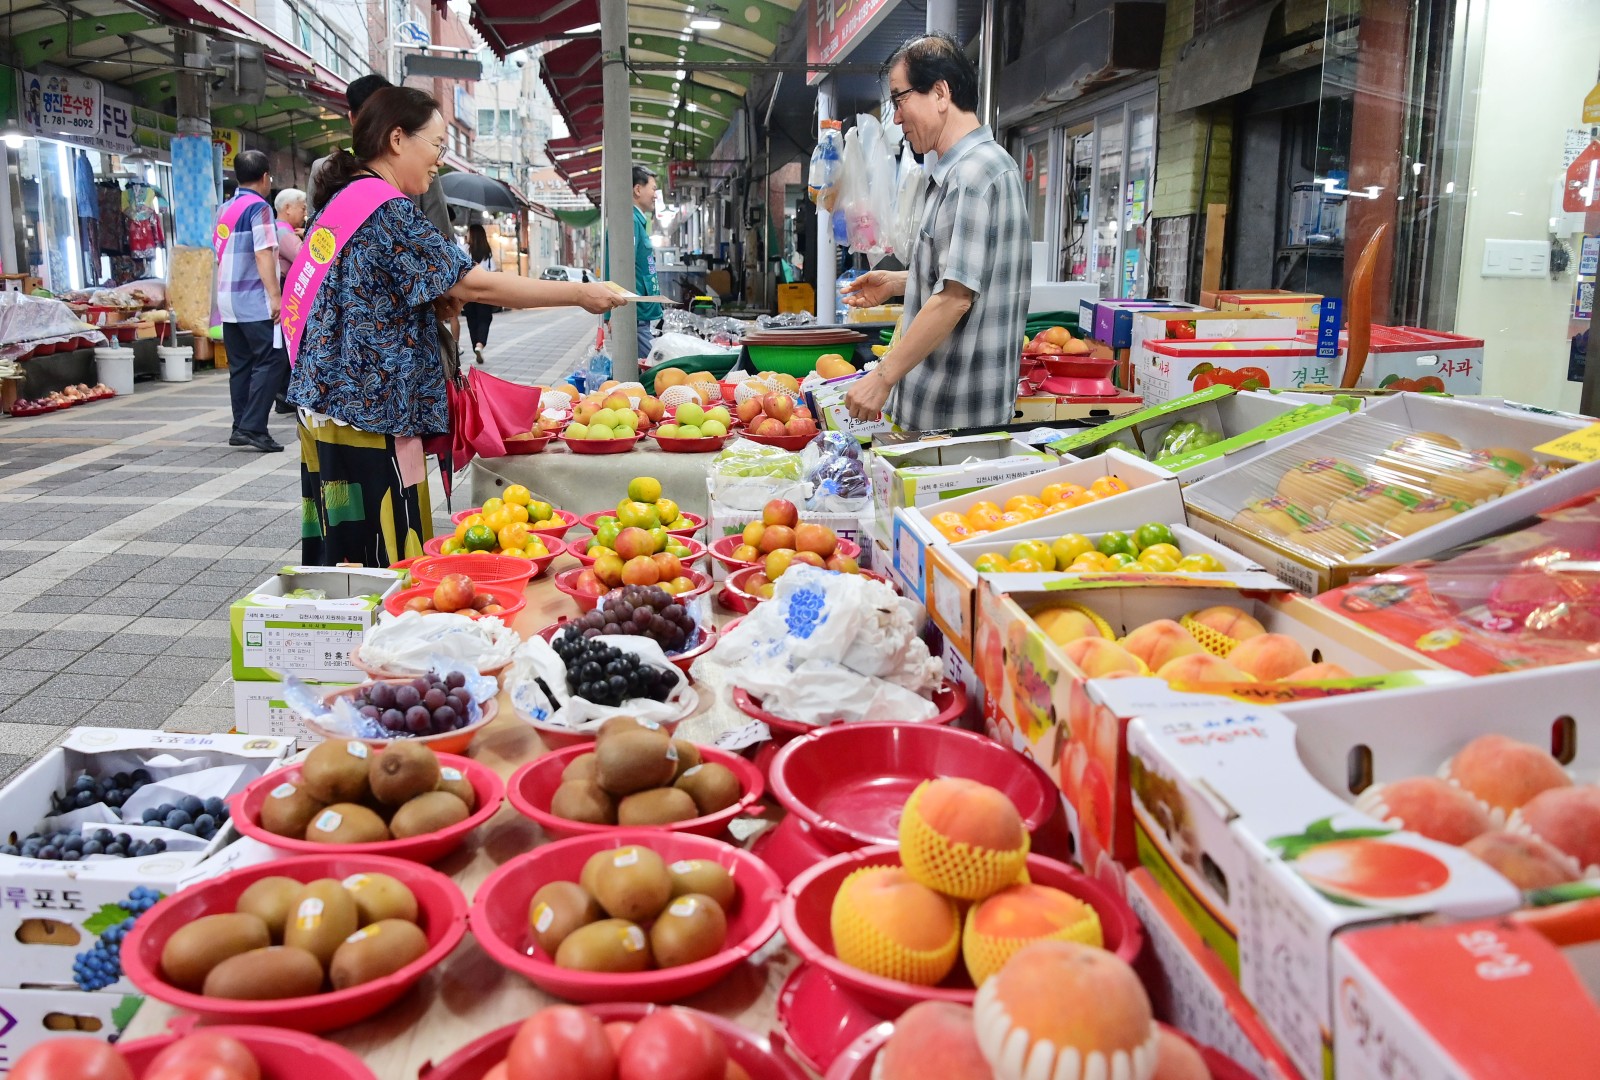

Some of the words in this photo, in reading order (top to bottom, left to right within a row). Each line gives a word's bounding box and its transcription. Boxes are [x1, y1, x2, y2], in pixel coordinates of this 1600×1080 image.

[43, 91, 95, 118] 명진혼수방
[52, 116, 94, 129] 781-8092
[1325, 301, 1336, 337] 미세요
[1320, 348, 1334, 356] VISA
[1291, 366, 1329, 388] 경북
[1437, 358, 1473, 377] 사과
[976, 475, 1004, 484] 김천시에서
[1006, 471, 1028, 480] 지원하는
[0, 888, 85, 912] 루포도
